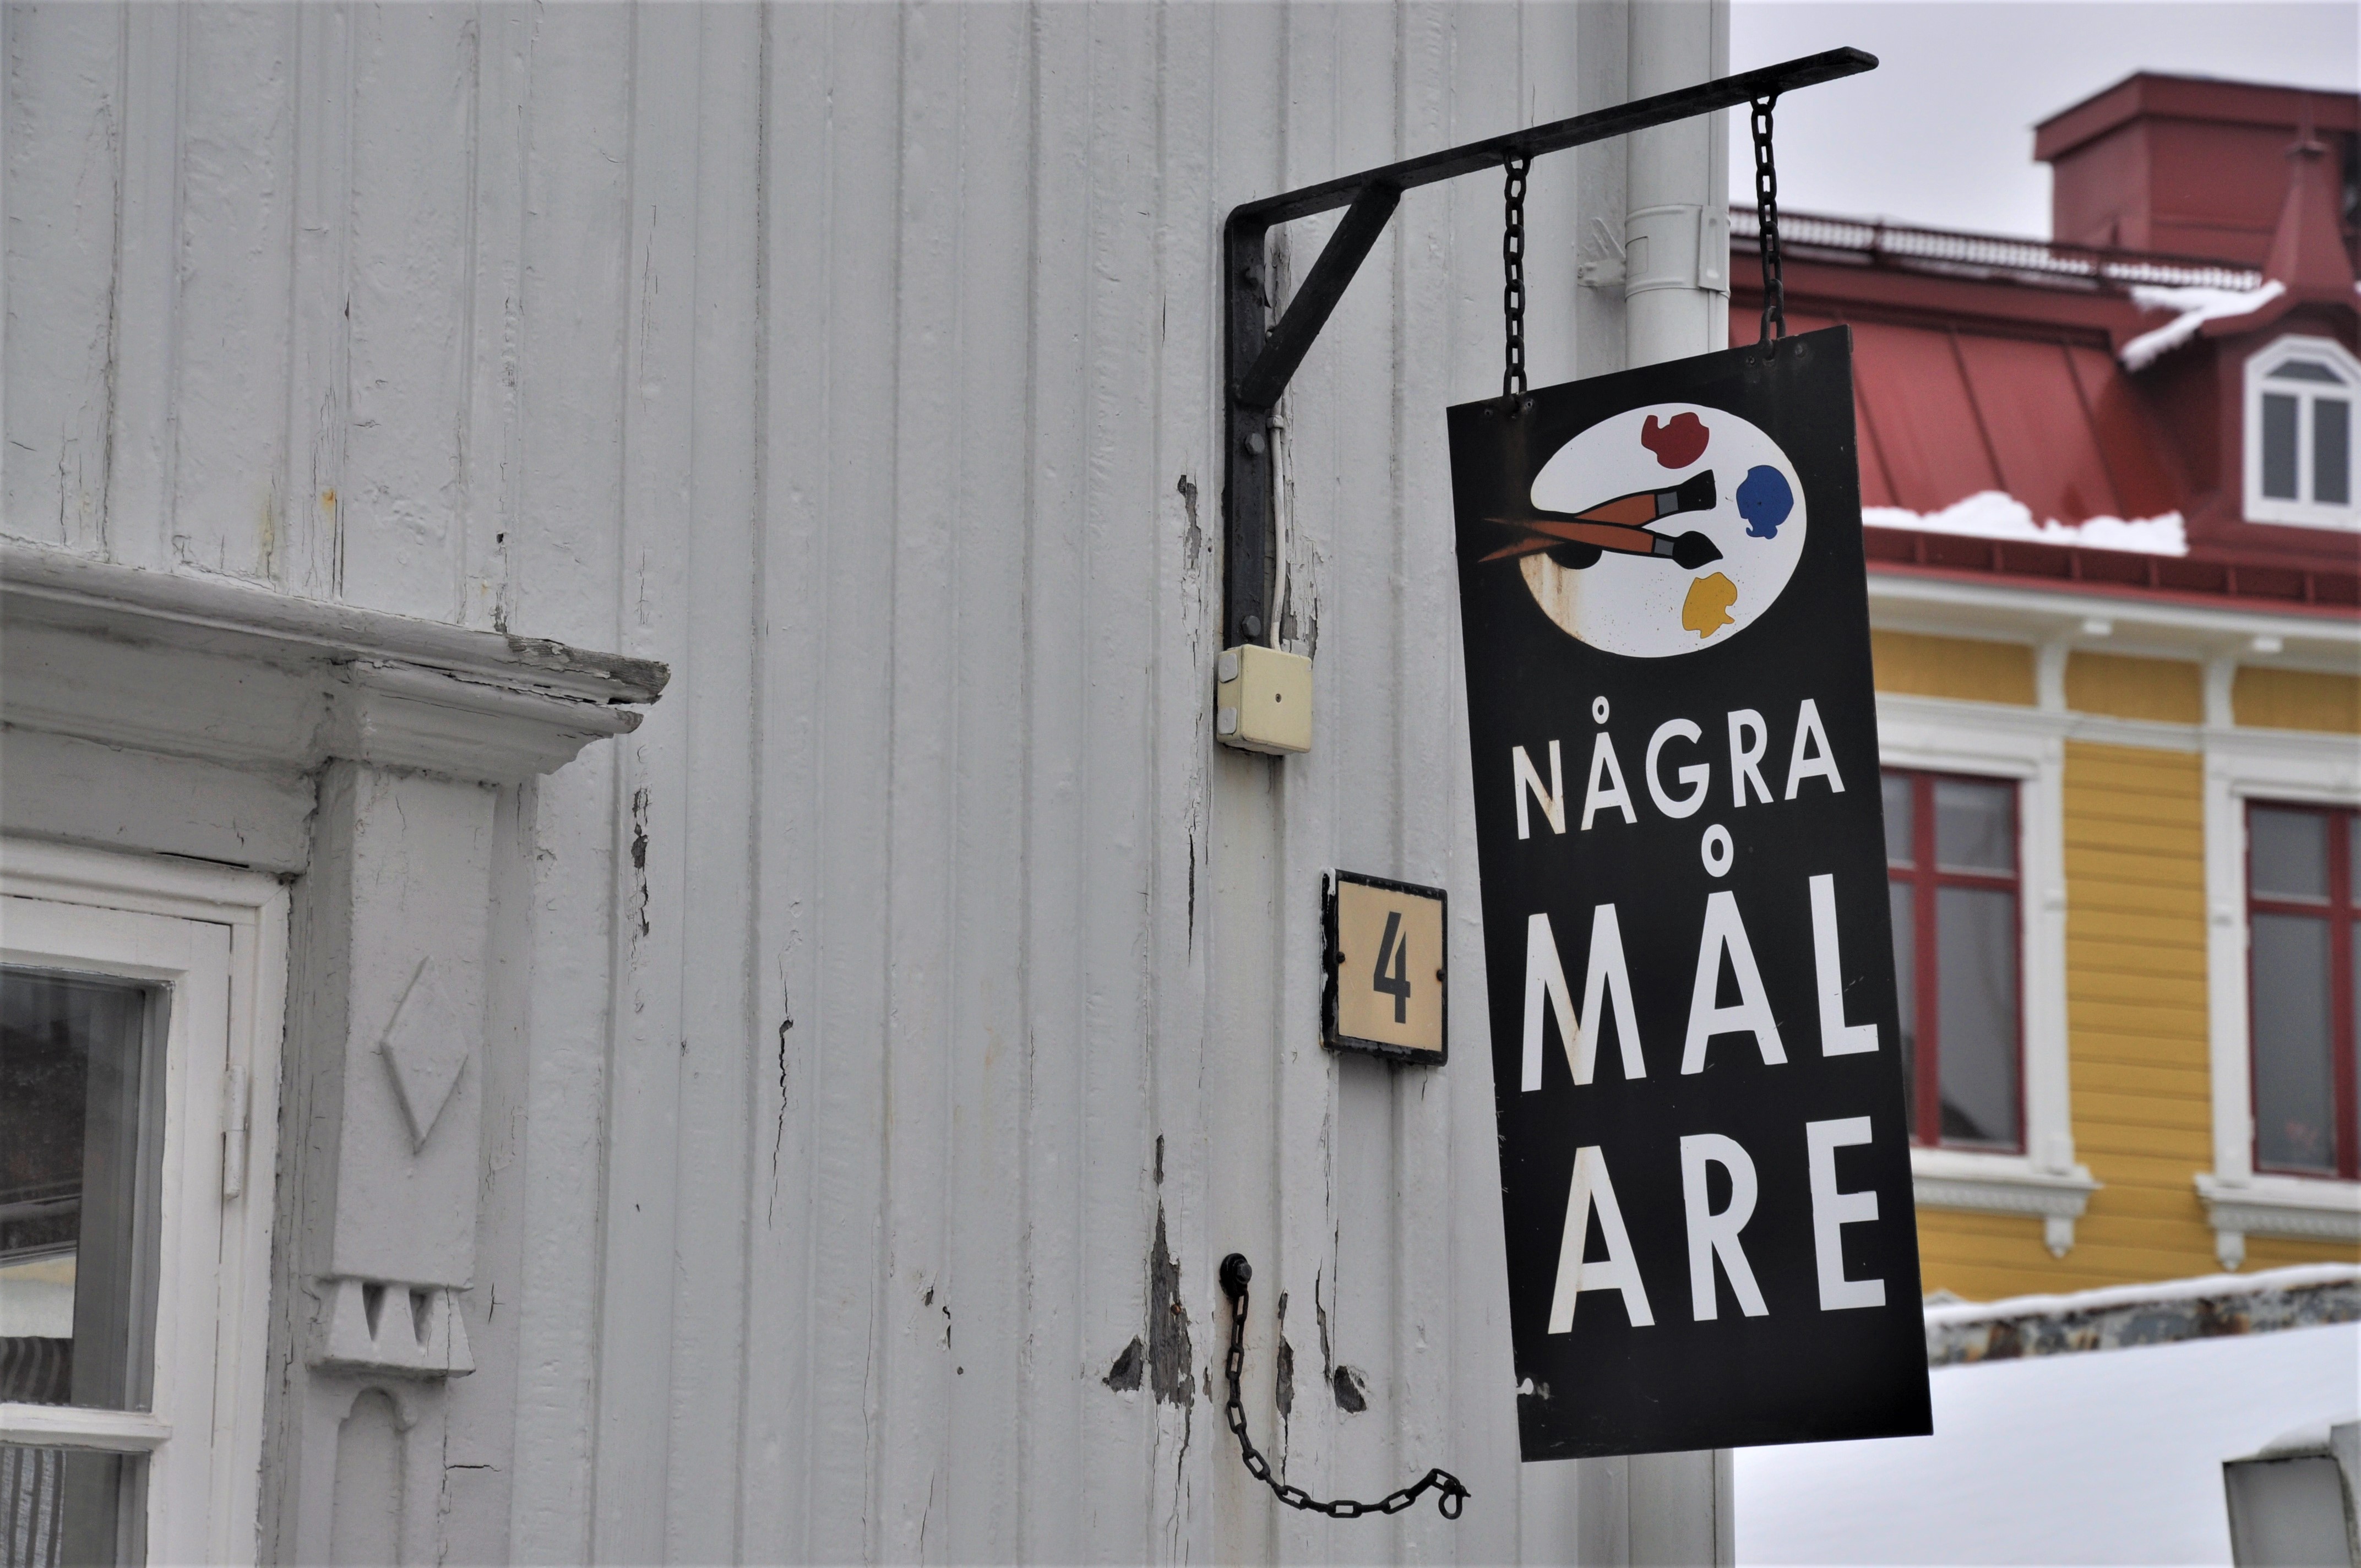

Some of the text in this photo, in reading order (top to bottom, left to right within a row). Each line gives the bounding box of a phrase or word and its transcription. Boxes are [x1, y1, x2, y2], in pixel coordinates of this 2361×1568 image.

[1511, 695, 1846, 841] NÅGRA
[1373, 911, 1412, 1024] 4
[1520, 823, 1880, 1092] MÅL
[1547, 1115, 1886, 1336] ARE
